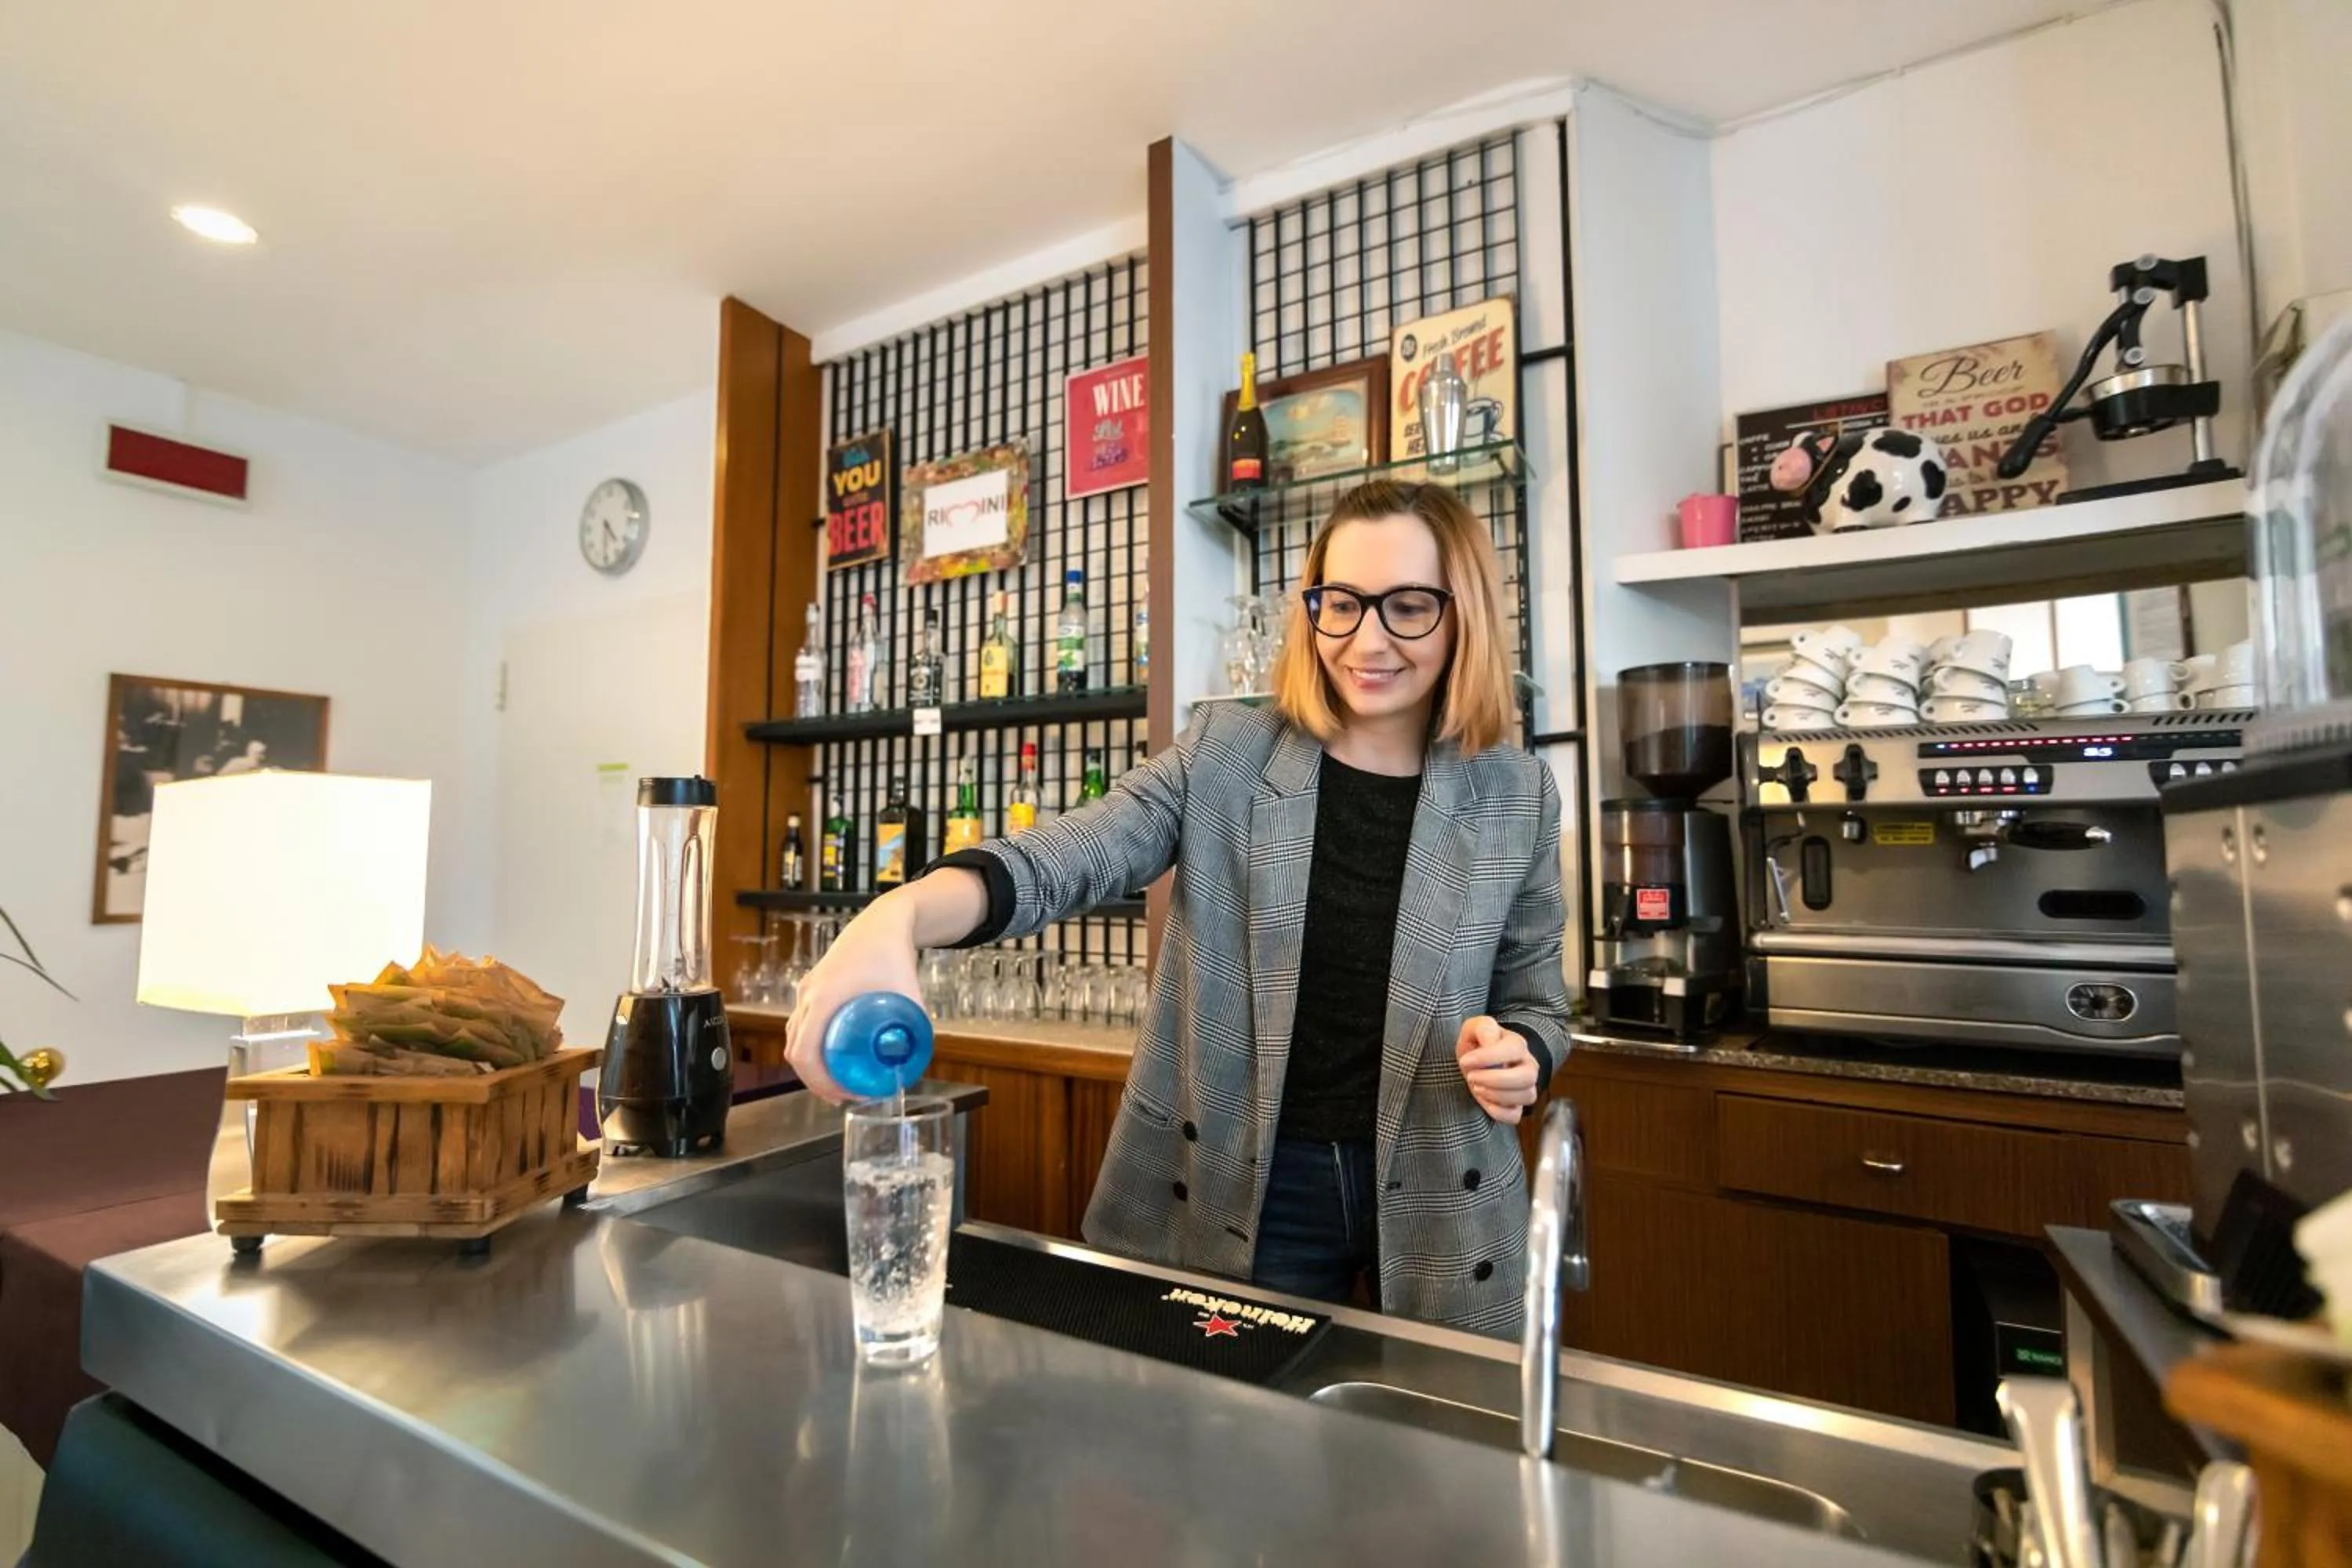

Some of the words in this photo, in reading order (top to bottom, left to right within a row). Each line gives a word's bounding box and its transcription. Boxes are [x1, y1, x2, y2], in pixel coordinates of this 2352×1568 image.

[1093, 373, 1145, 417] WINE
[1918, 355, 2025, 398] Beer
[1900, 405, 1973, 430] THAT
[1982, 393, 2049, 418] GOD
[833, 459, 881, 496] YOU
[1936, 480, 2060, 517] APPY
[828, 501, 886, 556] BEER
[1169, 1288, 1316, 1334] Heineken
